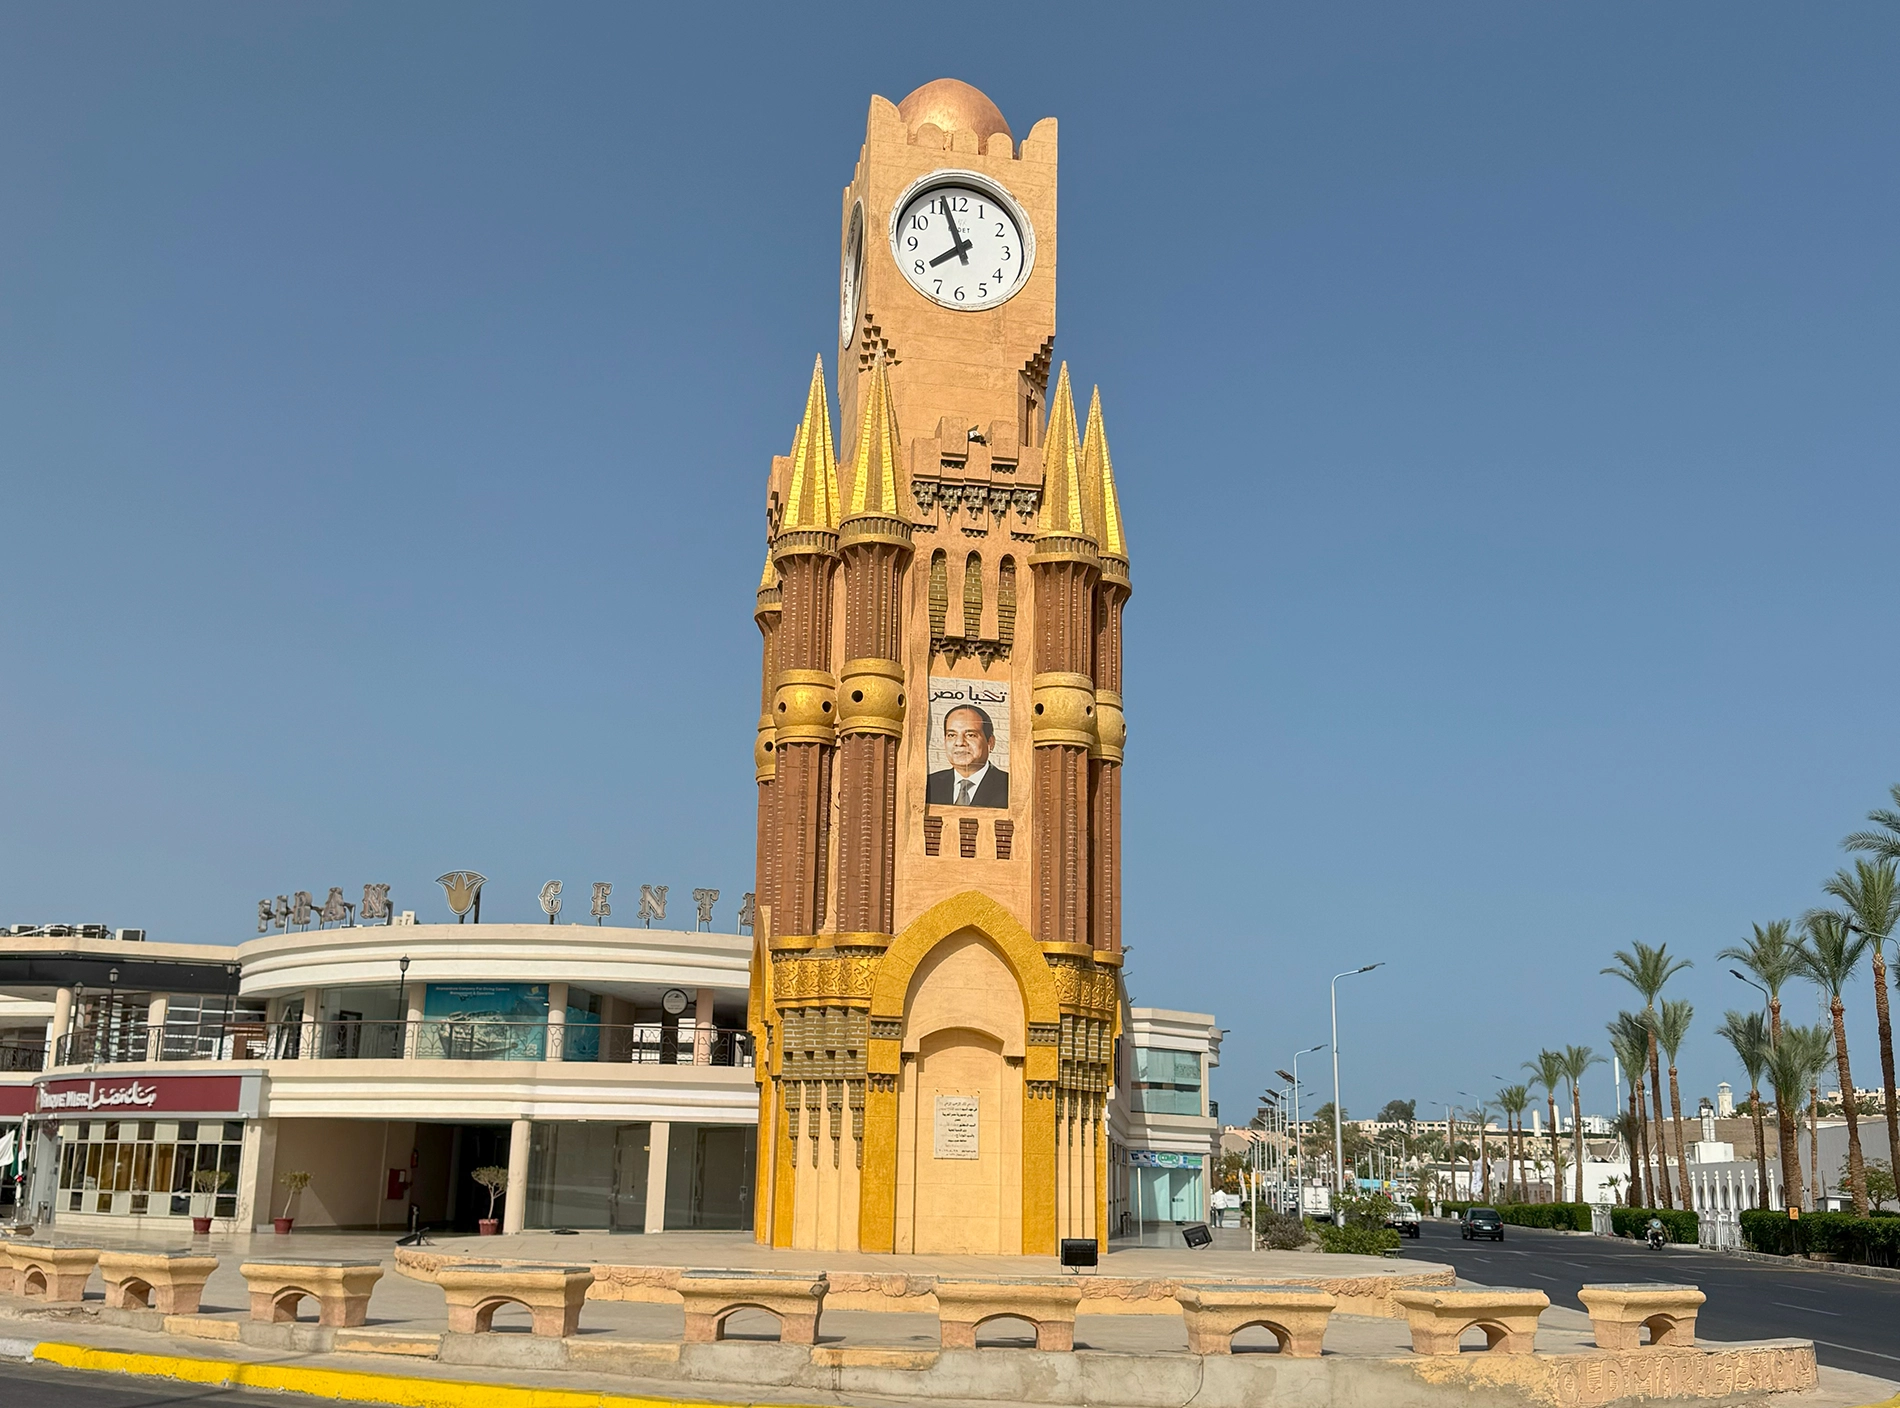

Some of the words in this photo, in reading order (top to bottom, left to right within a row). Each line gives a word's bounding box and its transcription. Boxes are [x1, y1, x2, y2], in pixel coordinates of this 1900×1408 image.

[930, 199, 945, 215] 11
[951, 197, 969, 212] 12
[978, 204, 985, 219] 1
[911, 215, 928, 231] 10
[995, 222, 1006, 237] 2
[907, 236, 918, 251] 9
[1001, 245, 1011, 261] 3
[914, 259, 925, 275] 8
[992, 268, 1003, 283] 4
[933, 279, 943, 294] 7
[954, 286, 965, 301] 6
[977, 282, 987, 298] 5
[929, 690, 965, 702] مصر
[968, 685, 1008, 704] تحيا
[1558, 1359, 1624, 1404] OLD
